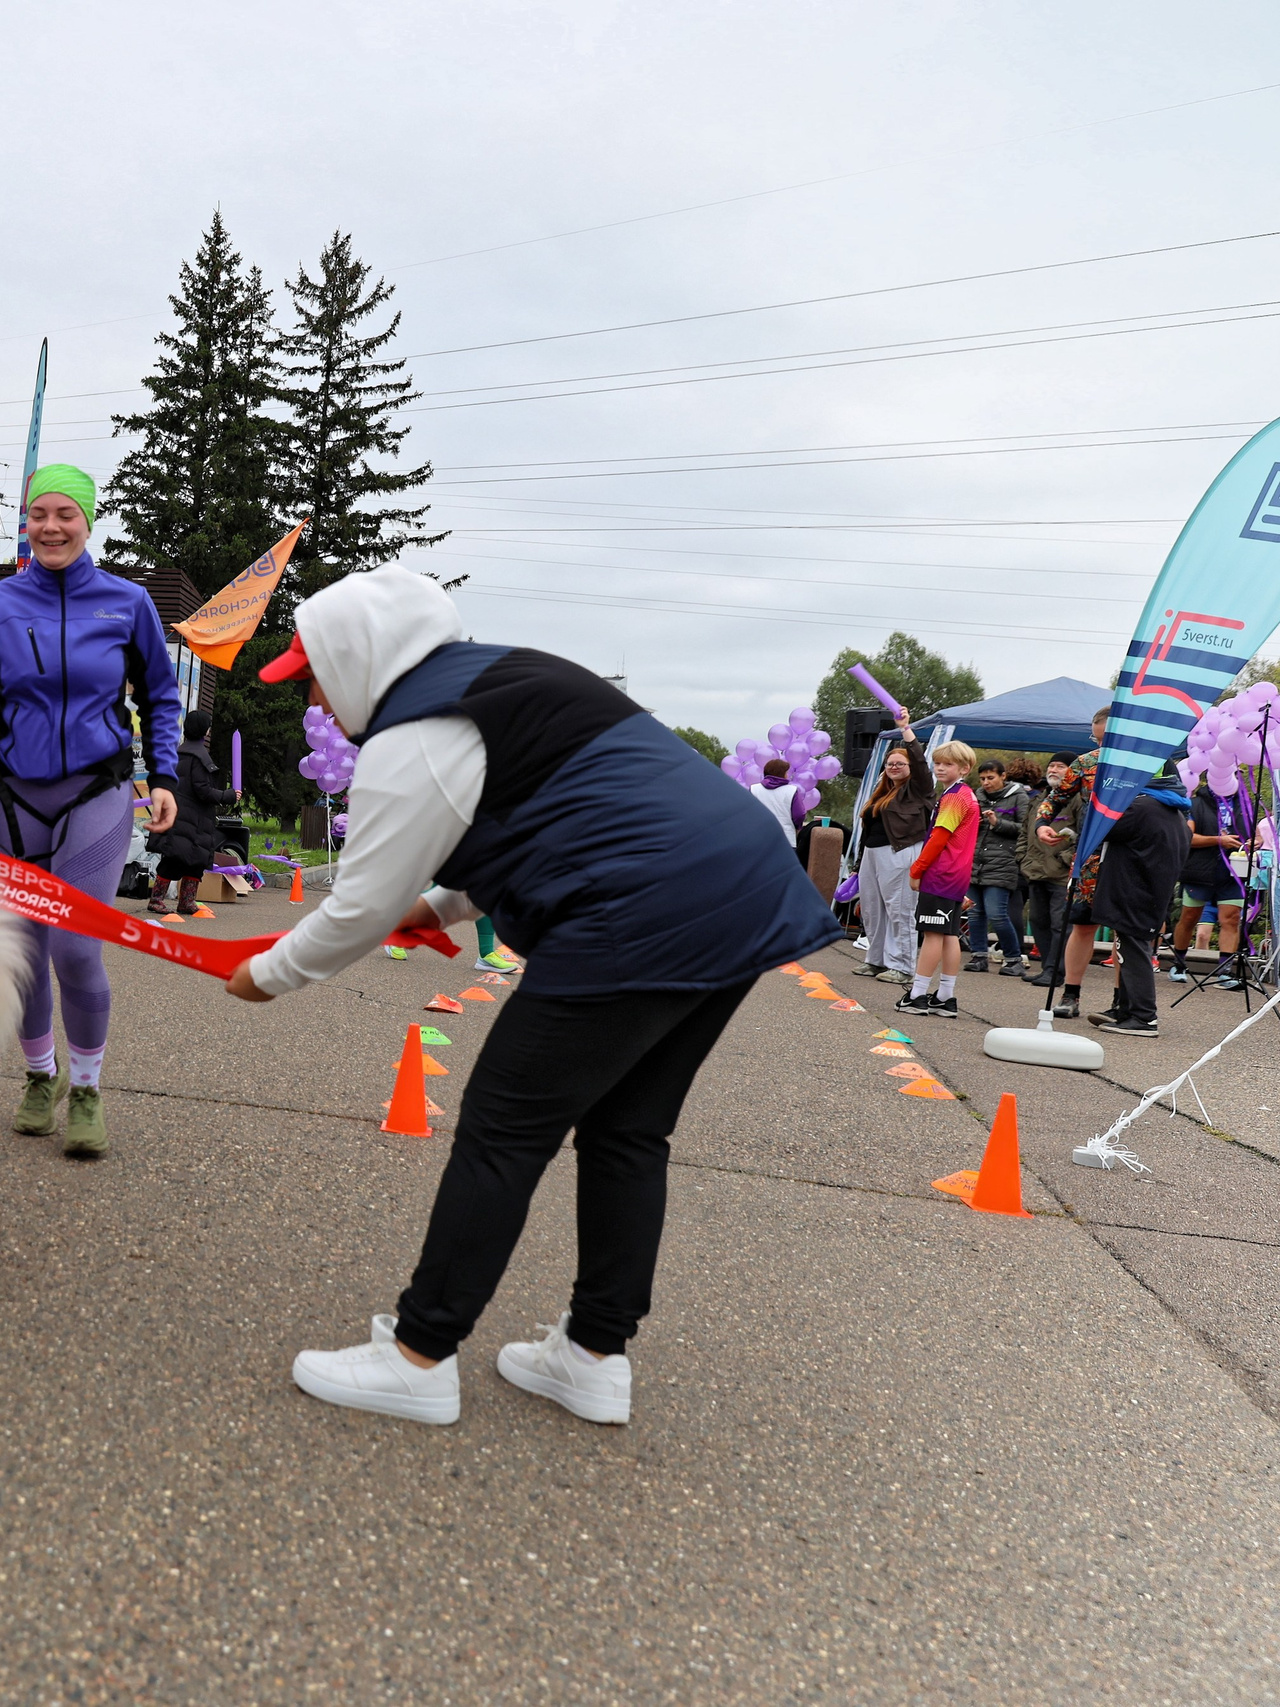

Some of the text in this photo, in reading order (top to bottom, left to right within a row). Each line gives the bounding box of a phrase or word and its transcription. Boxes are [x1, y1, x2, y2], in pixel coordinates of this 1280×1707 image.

[1181, 628, 1234, 649] 5verst.ru
[120, 918, 142, 942] 5
[919, 915, 945, 925] PUMA
